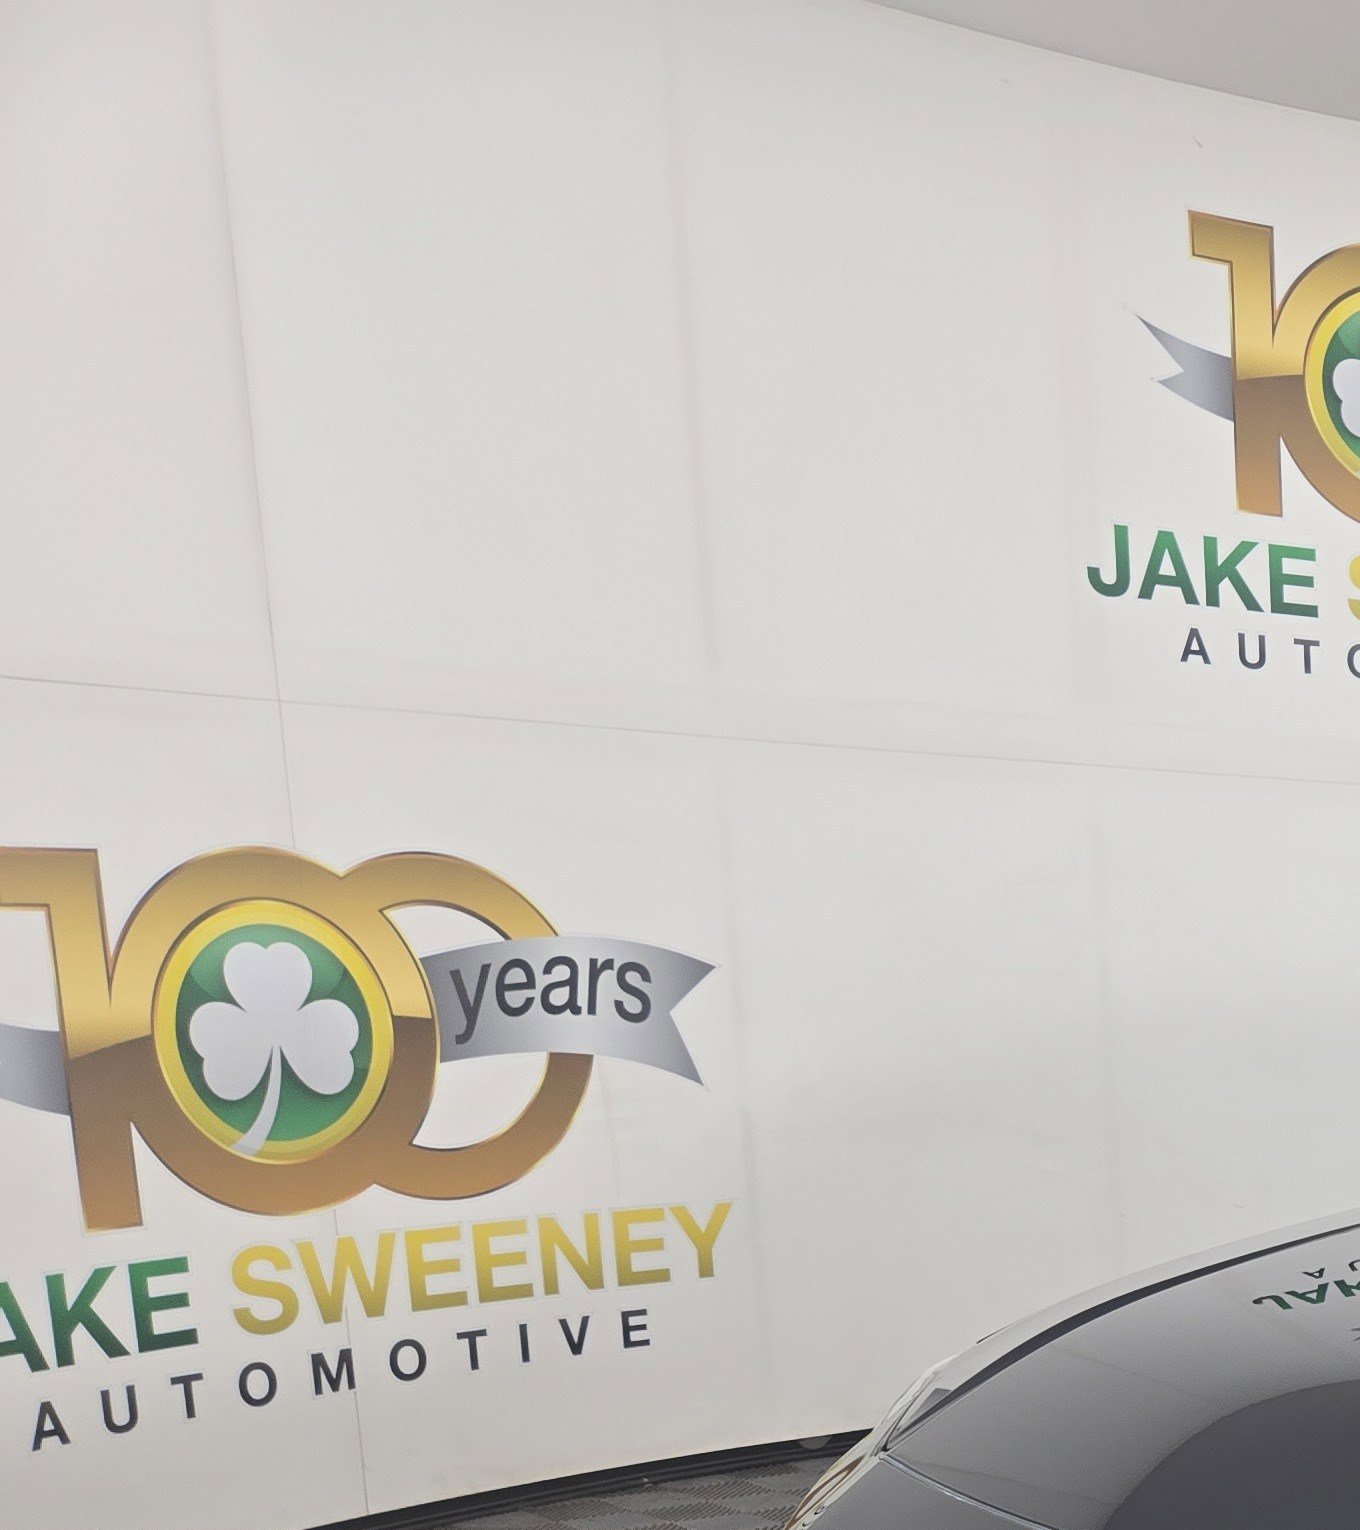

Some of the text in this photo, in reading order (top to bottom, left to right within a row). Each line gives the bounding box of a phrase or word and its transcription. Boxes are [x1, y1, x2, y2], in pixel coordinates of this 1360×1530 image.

[1087, 523, 1320, 619] JAKE
[449, 955, 653, 1046] years
[0, 1201, 734, 1373] AKE SWEENEY
[31, 1308, 651, 1451] AUTOMOTIVE
